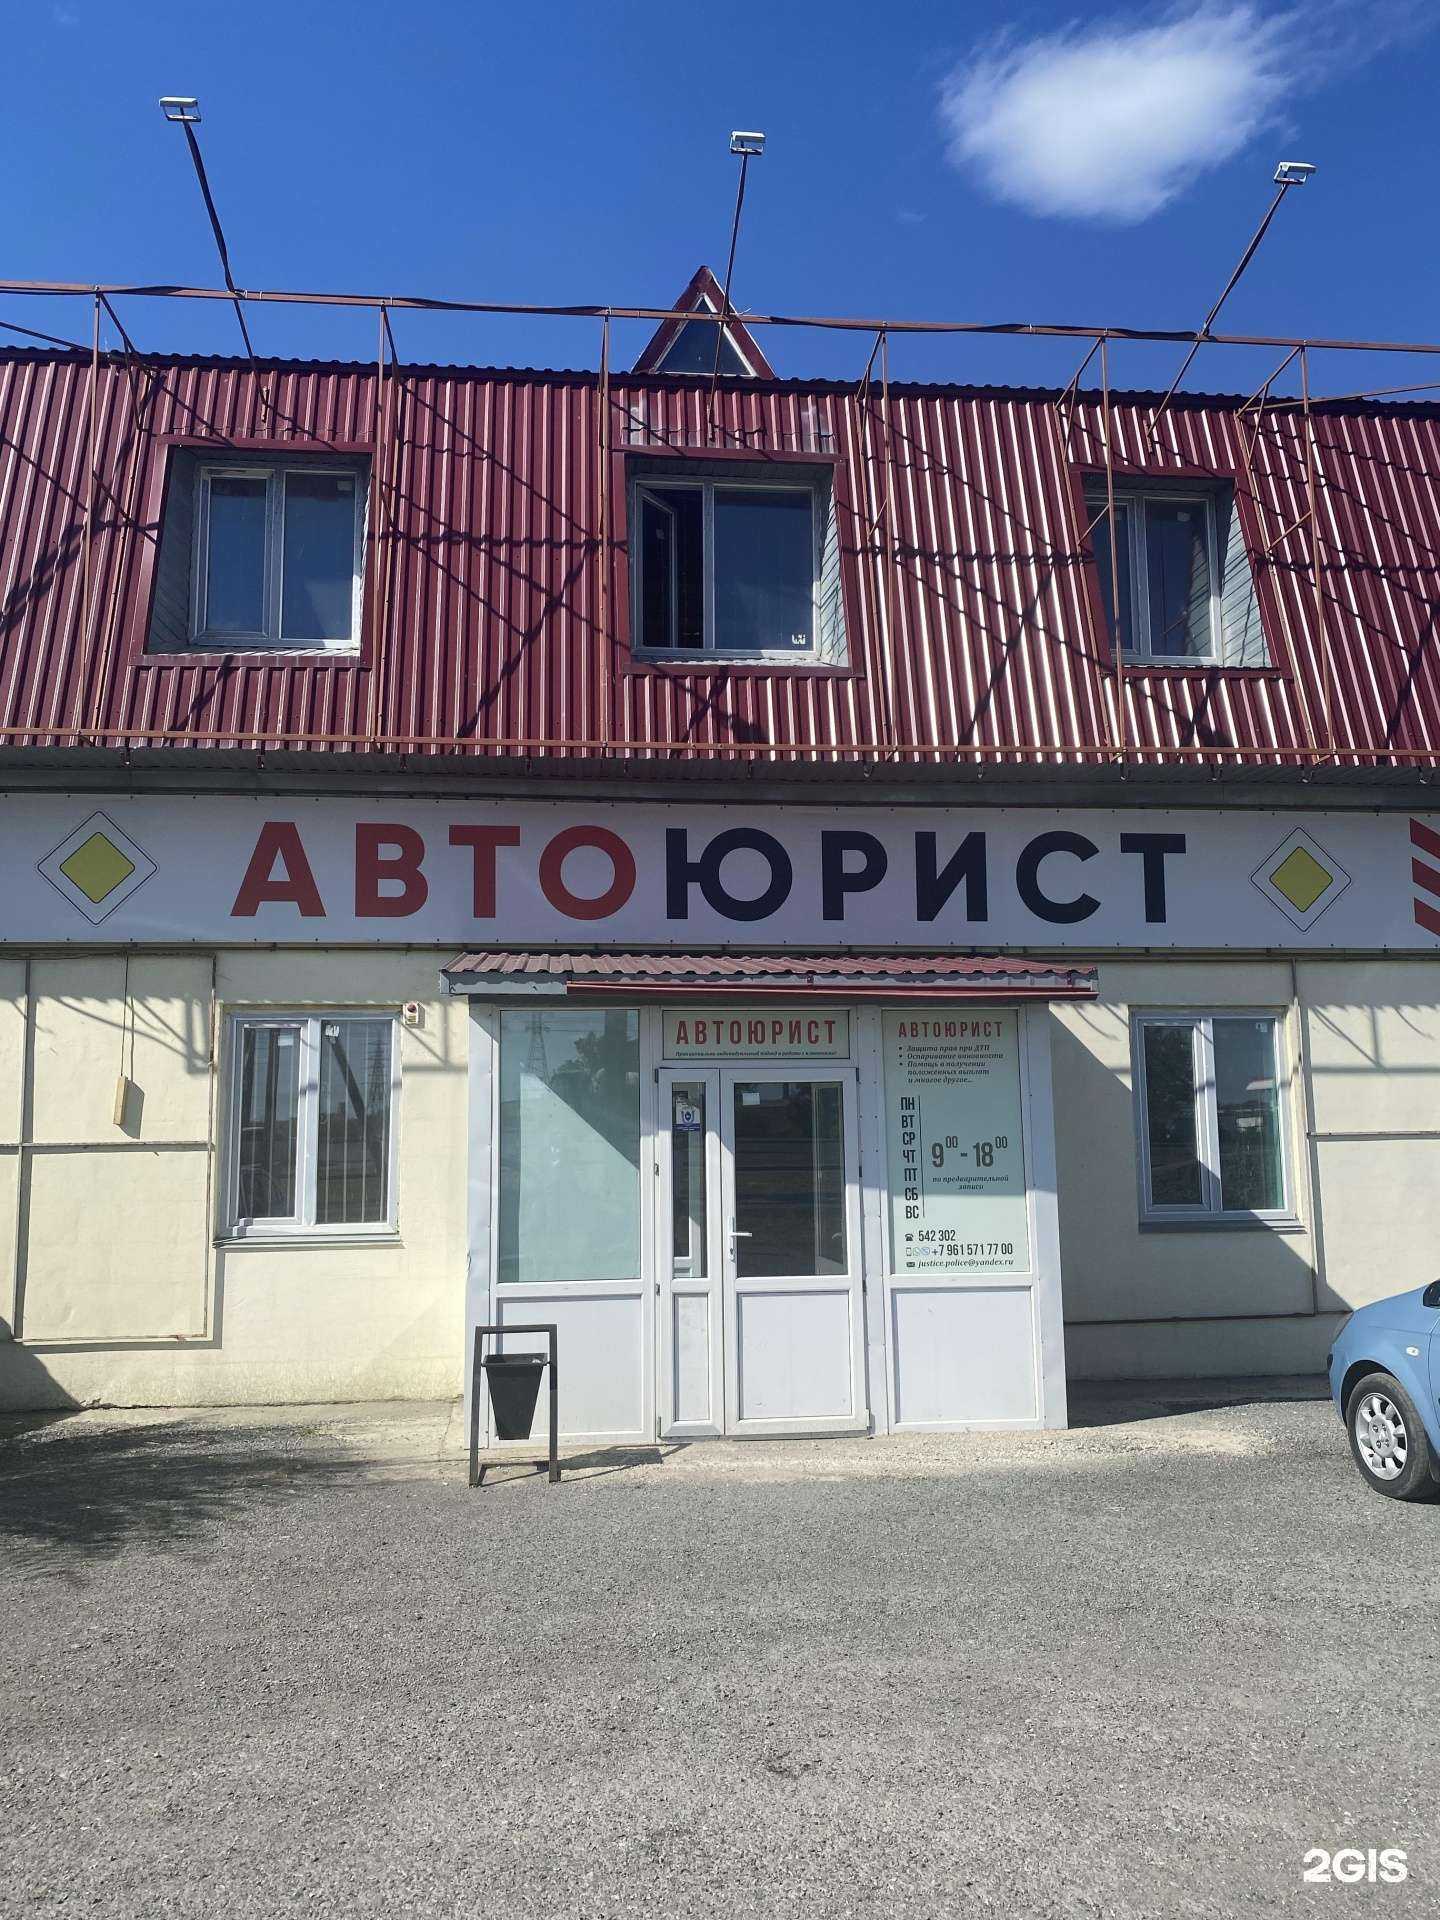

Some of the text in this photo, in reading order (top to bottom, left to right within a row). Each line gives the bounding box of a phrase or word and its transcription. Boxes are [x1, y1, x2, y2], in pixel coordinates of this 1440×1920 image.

[230, 820, 1187, 924] АВТОЮРИСТ
[676, 1020, 836, 1045] АВТОЮРИСТ
[898, 1021, 1003, 1037] АВТОЮРИСТ
[960, 1045, 973, 1053] при
[974, 1044, 990, 1052] ДТП
[901, 1097, 915, 1110] ПН
[902, 1115, 915, 1128] ВТ
[903, 1132, 916, 1145] СР
[903, 1150, 916, 1163] ЧТ
[904, 1168, 917, 1181] ПТ
[943, 1175, 1009, 1184] предварительной
[905, 1187, 918, 1201] СБ
[906, 1205, 919, 1219] ВС
[918, 1230, 956, 1241] 542 302
[932, 1243, 1013, 1256] +7 961 571 77 00
[918, 1258, 1014, 1268] justice.police@yandex.ru
